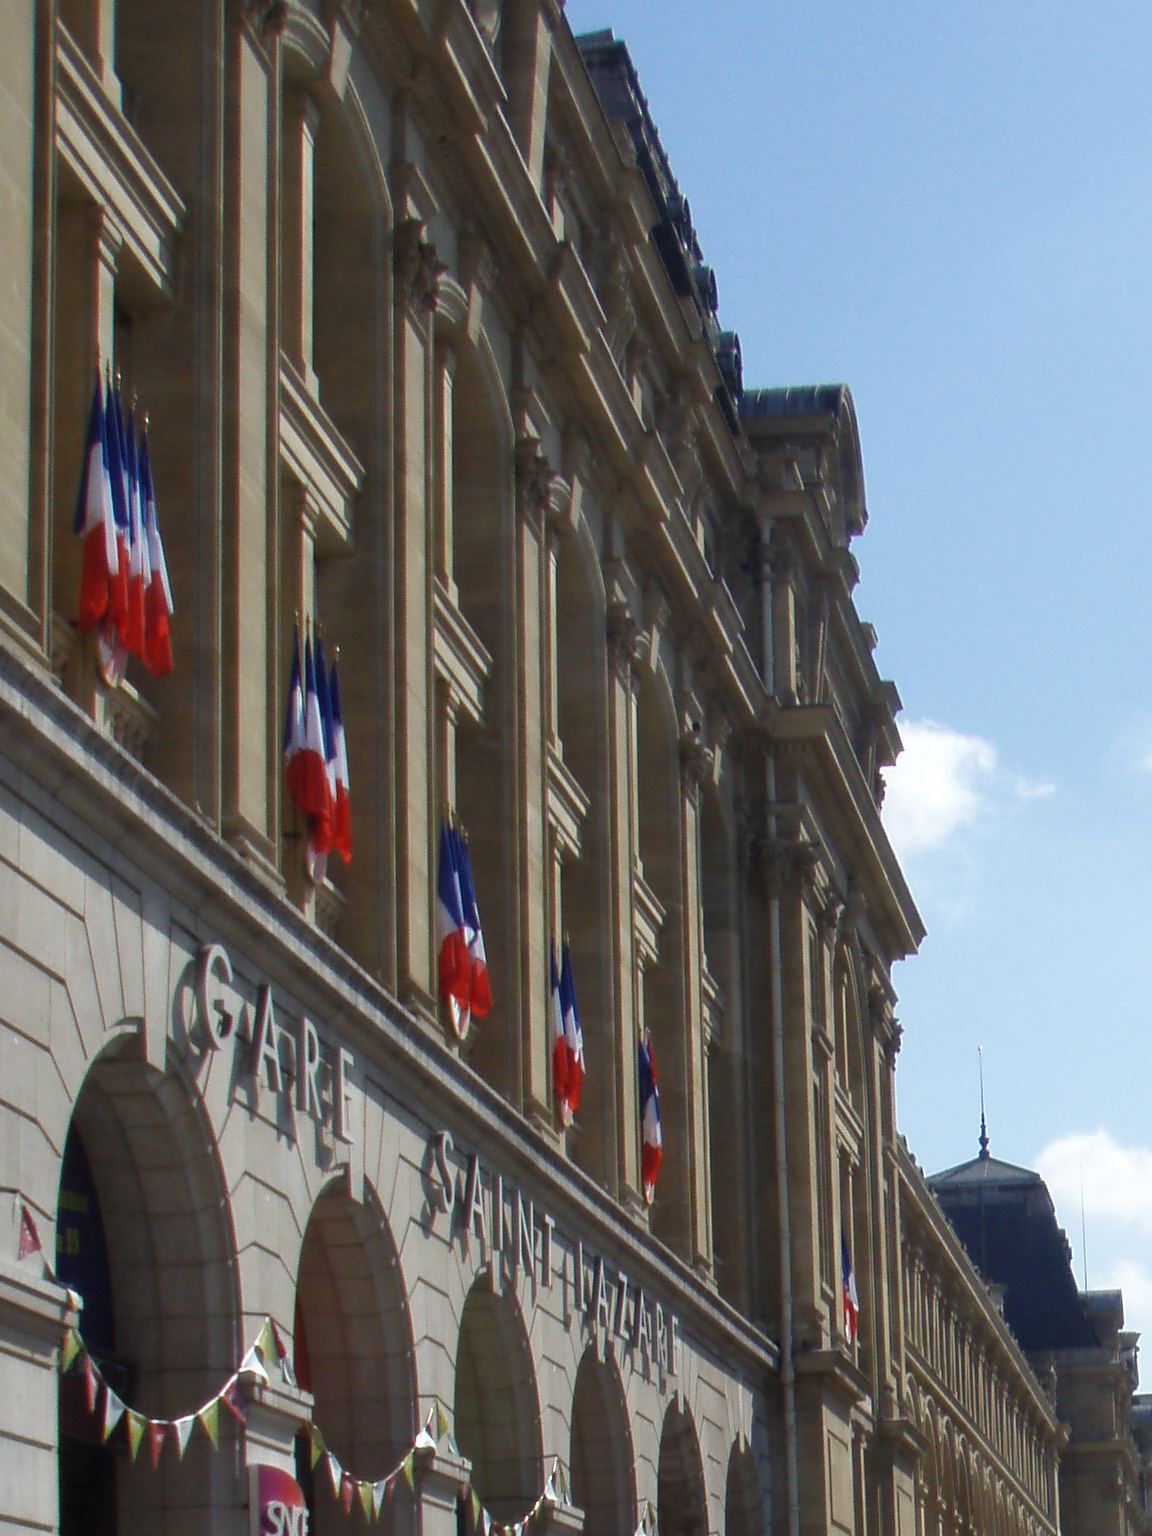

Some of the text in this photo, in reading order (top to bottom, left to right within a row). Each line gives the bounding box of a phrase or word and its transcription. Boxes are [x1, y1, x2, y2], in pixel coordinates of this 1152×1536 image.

[195, 943, 679, 1376] GARE SAINT LAZARE
